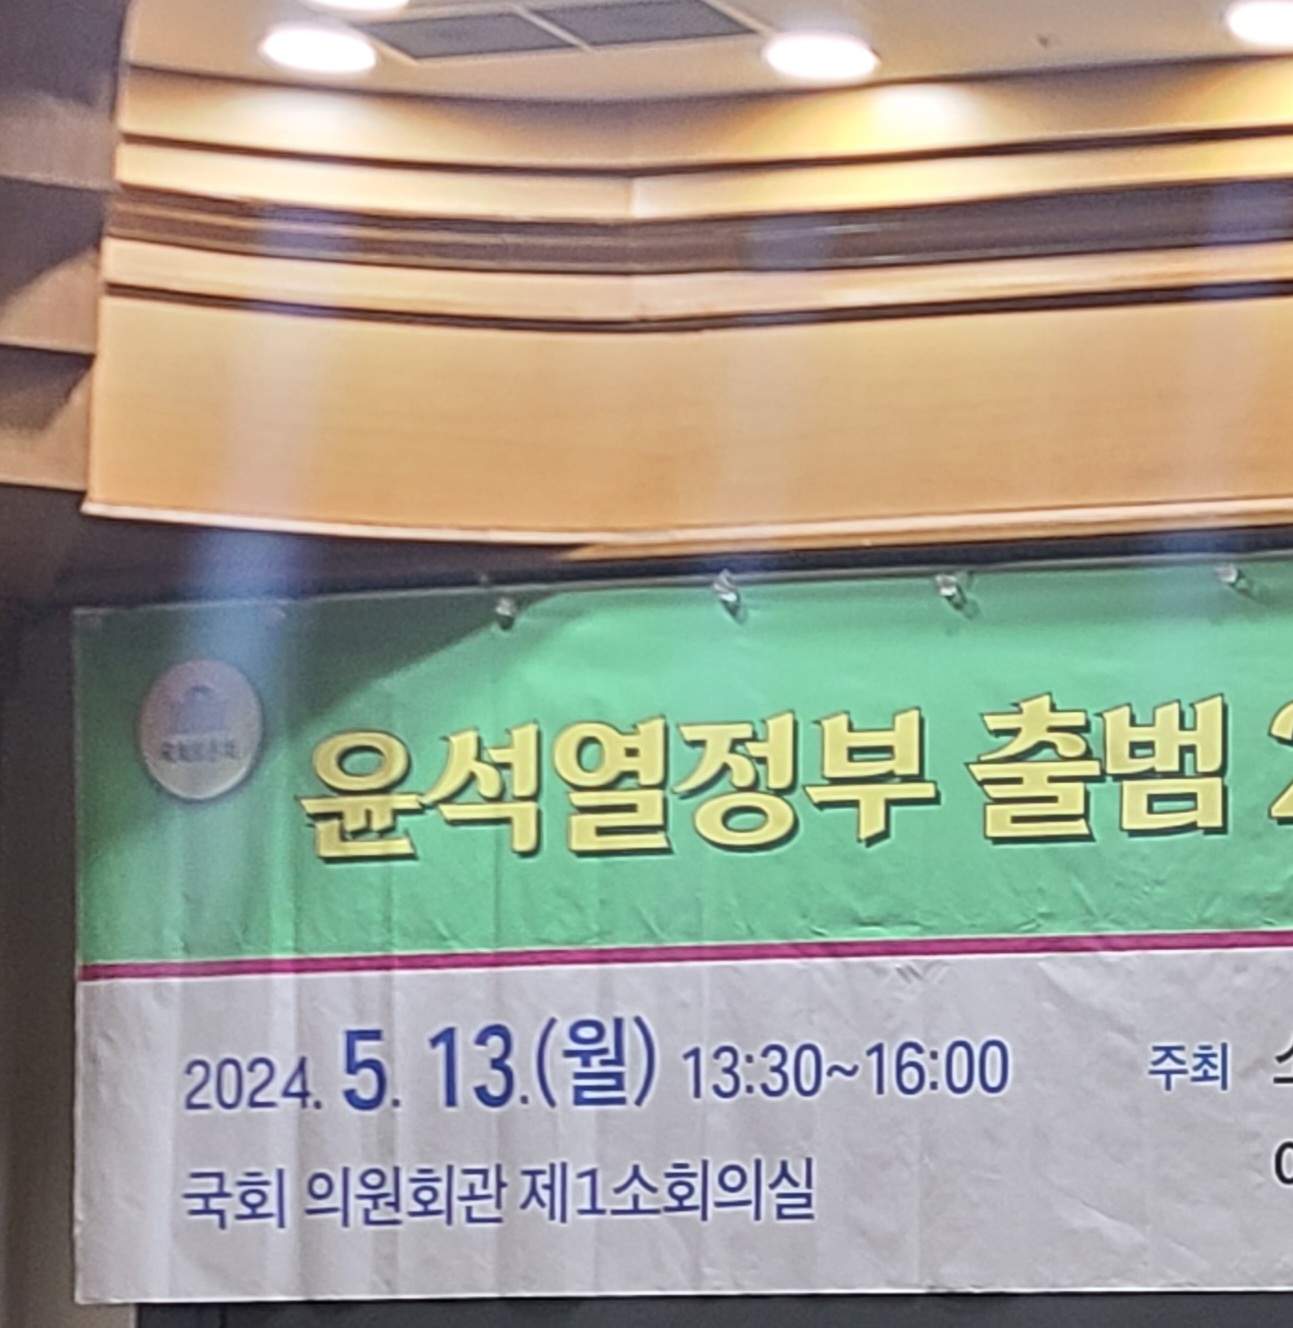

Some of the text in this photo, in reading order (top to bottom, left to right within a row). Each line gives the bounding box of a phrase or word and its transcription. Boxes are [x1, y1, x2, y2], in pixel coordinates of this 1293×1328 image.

[298, 708, 940, 864] 윤석열정부
[968, 691, 1230, 846] 출범
[185, 1056, 322, 1110] 2024.
[683, 1040, 1008, 1098] 13:30~16:00
[1149, 1043, 1227, 1091] 주최
[182, 1157, 814, 1230] 국회 의원회관 제1소회의실
